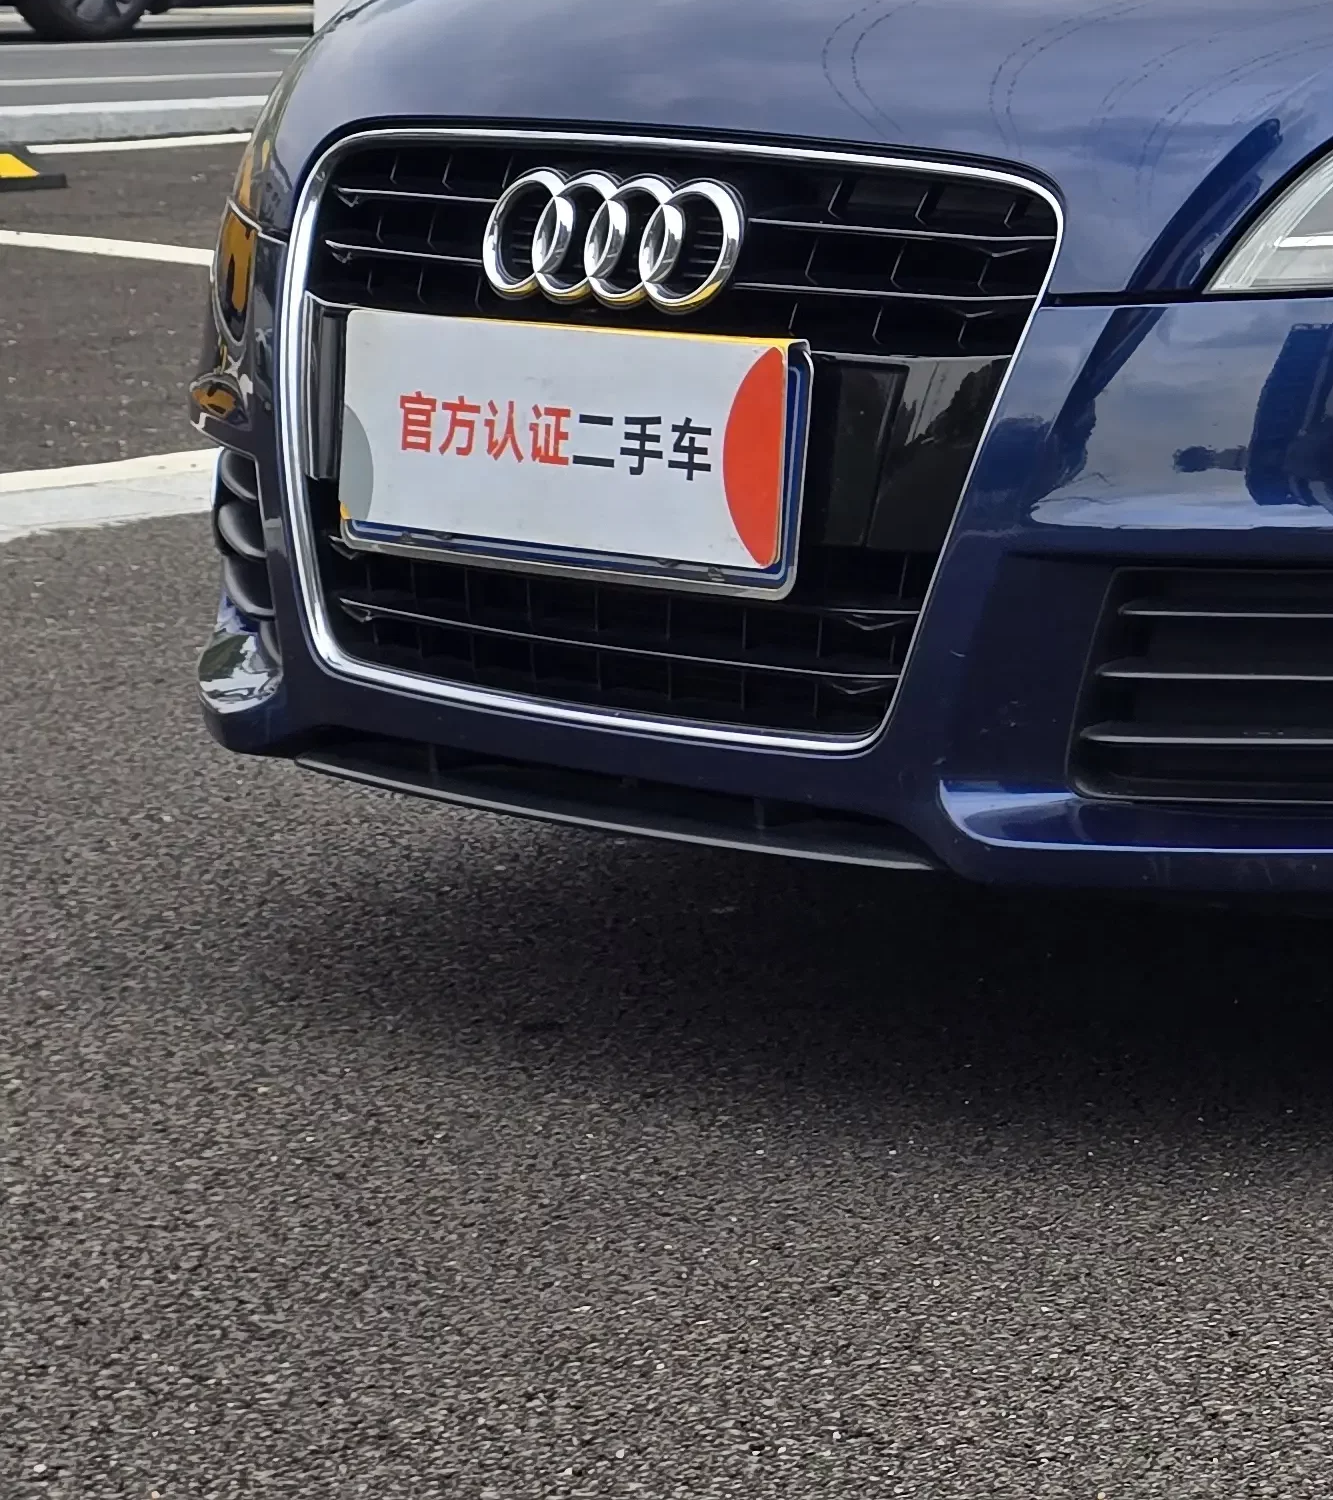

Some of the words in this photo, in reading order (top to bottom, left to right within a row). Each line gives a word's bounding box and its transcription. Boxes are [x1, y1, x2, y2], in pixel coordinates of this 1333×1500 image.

[398, 390, 713, 483] 官方认证二手车
